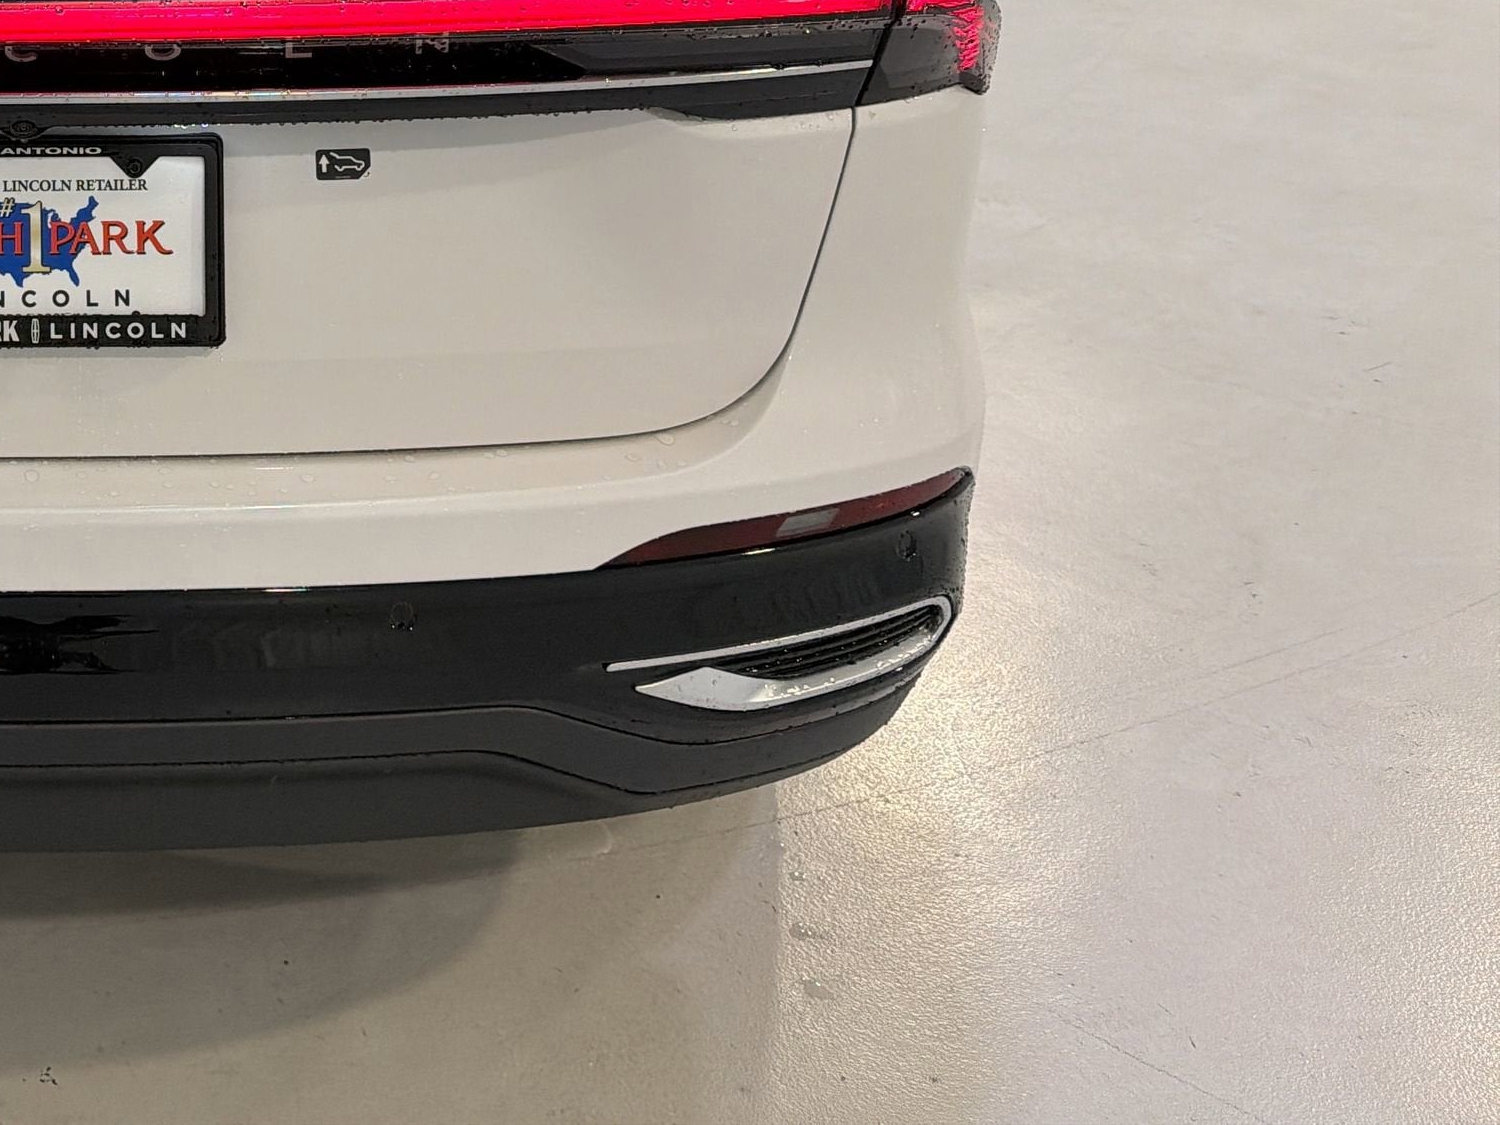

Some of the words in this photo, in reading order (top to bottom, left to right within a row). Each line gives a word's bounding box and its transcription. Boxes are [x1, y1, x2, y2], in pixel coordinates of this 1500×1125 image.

[0, 146, 102, 155] ANTONIO
[2, 180, 72, 193] LINCOLN
[75, 178, 148, 192] RETAILER
[50, 219, 174, 256] PARK
[50, 322, 187, 341] LINCOLN
